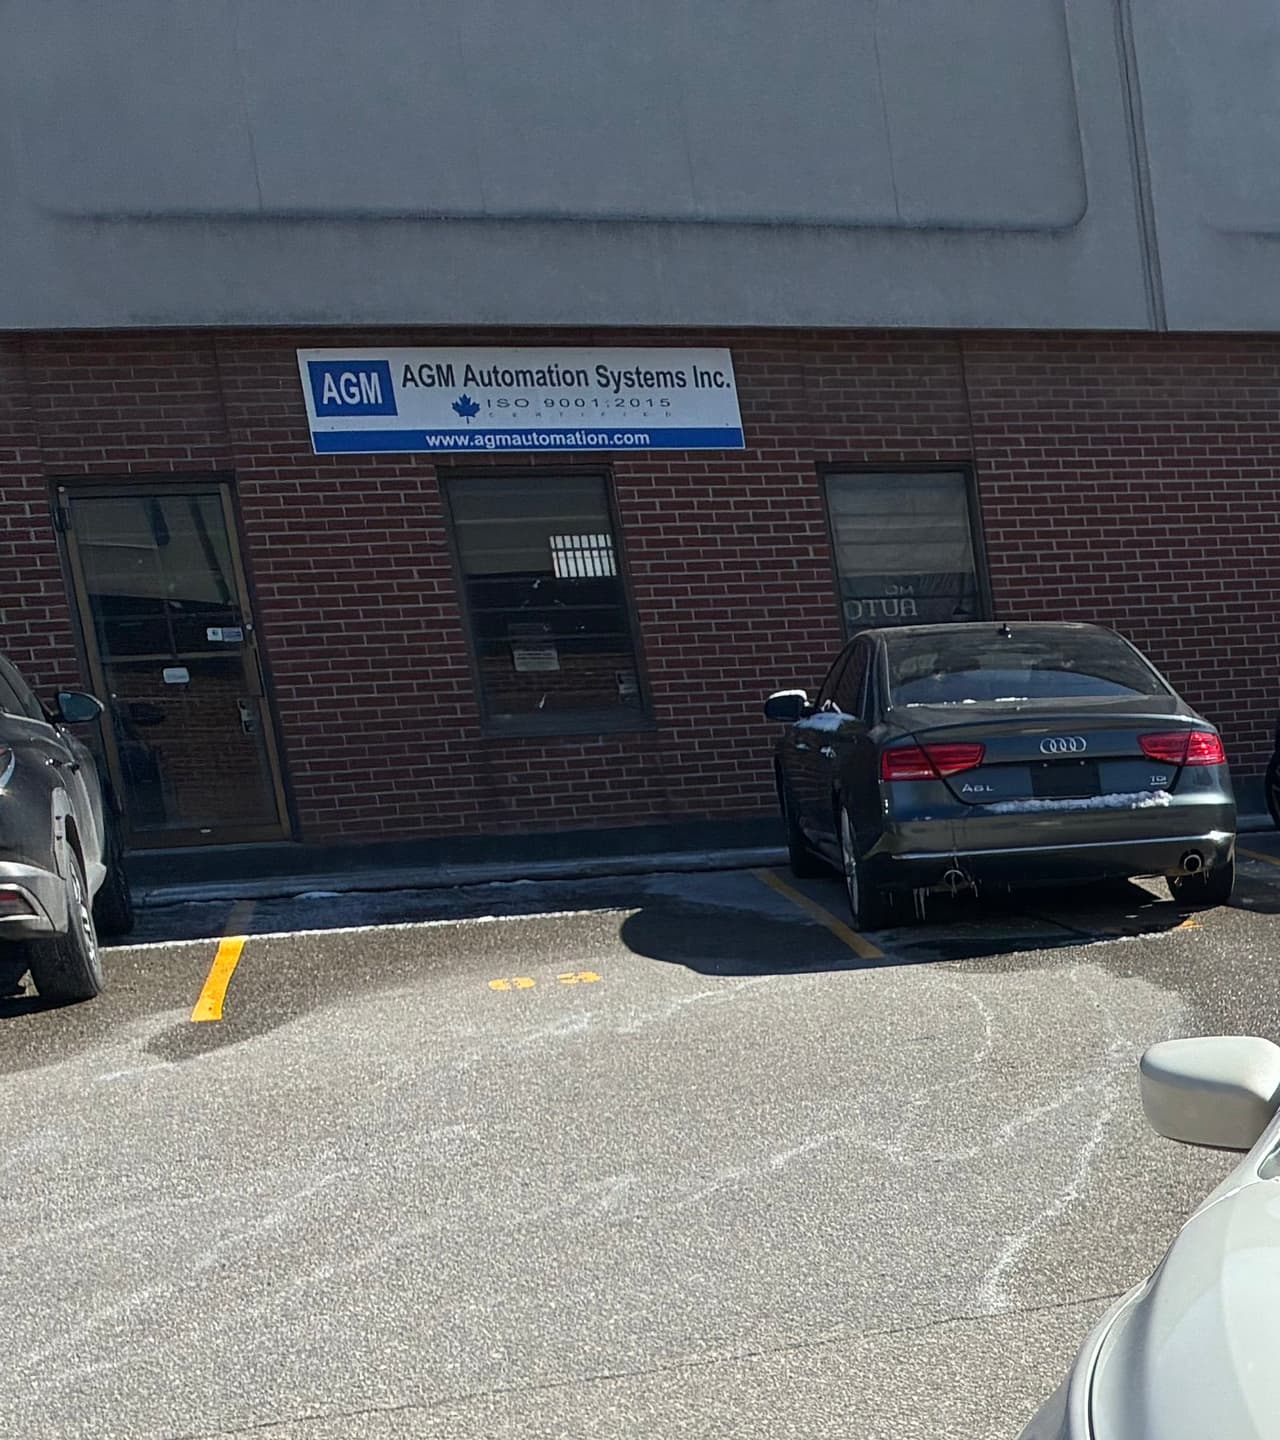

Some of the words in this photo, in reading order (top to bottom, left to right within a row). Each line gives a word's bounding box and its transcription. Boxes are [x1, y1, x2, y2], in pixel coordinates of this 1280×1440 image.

[322, 371, 383, 405] AGM
[402, 364, 456, 388] AGM
[463, 363, 589, 388] Automation
[595, 364, 687, 394] Systems
[692, 365, 731, 388] Inc.
[487, 398, 530, 408] ISO
[543, 398, 671, 408] 9001:2015
[426, 430, 650, 450] www.agmautomation.com
